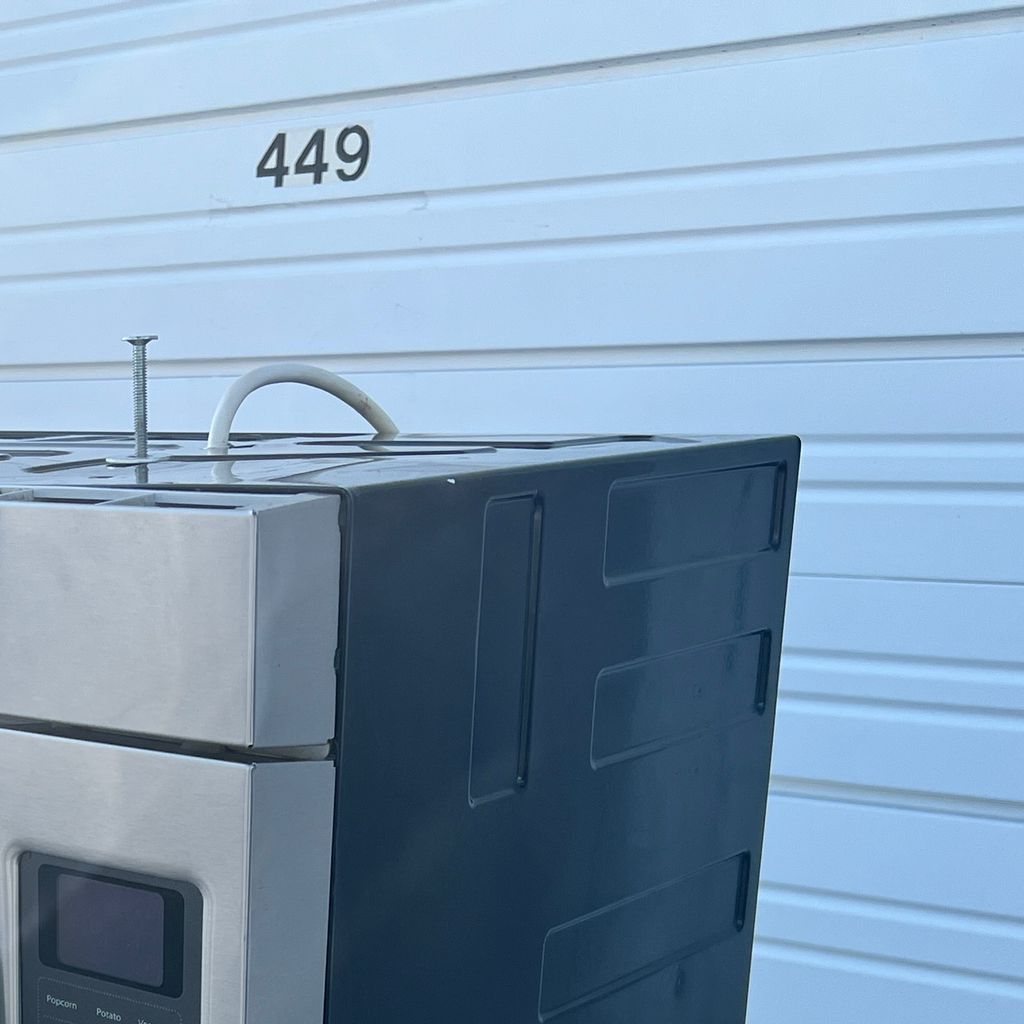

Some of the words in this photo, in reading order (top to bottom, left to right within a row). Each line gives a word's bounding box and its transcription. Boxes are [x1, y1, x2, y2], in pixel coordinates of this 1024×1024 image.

[256, 124, 370, 188] 449
[46, 995, 77, 1010] Popcorn
[96, 1008, 122, 1021] Potato
